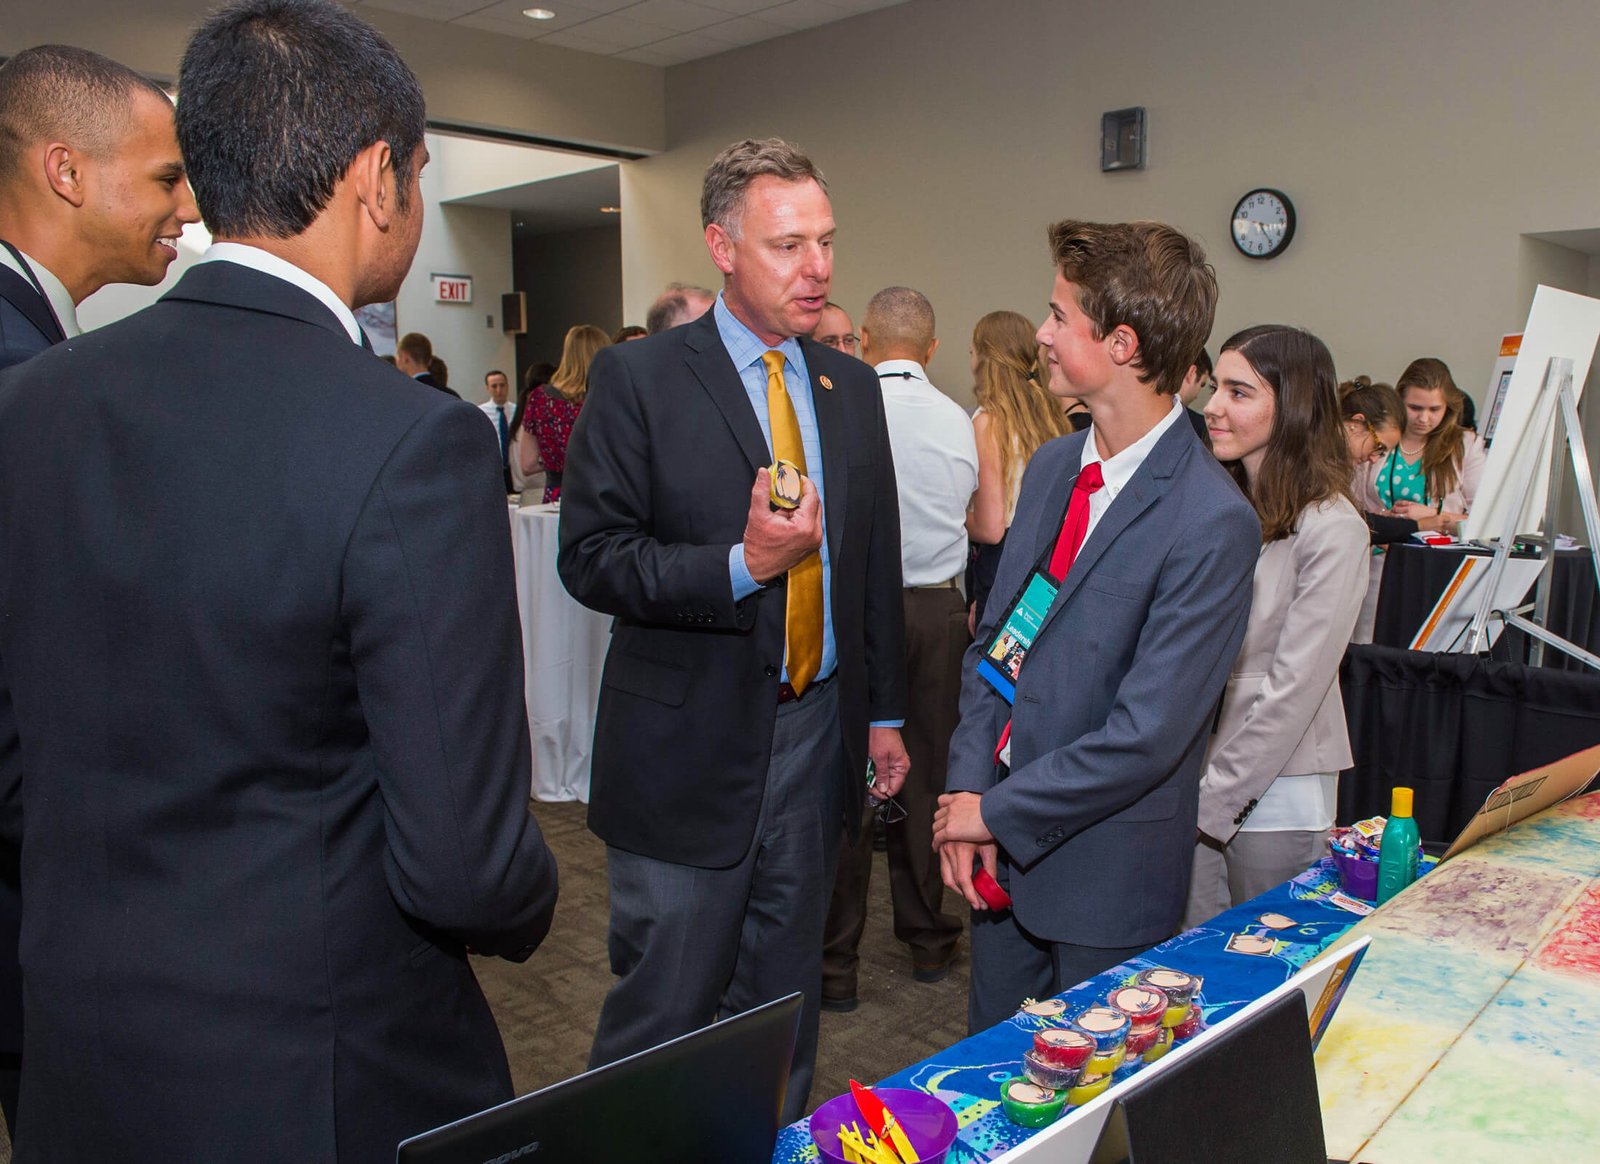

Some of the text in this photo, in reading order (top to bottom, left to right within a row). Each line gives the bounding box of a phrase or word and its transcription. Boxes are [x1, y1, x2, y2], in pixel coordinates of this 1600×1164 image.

[1257, 196, 1264, 204] 12
[1241, 210, 1248, 219] 10
[440, 281, 467, 300] EXIT
